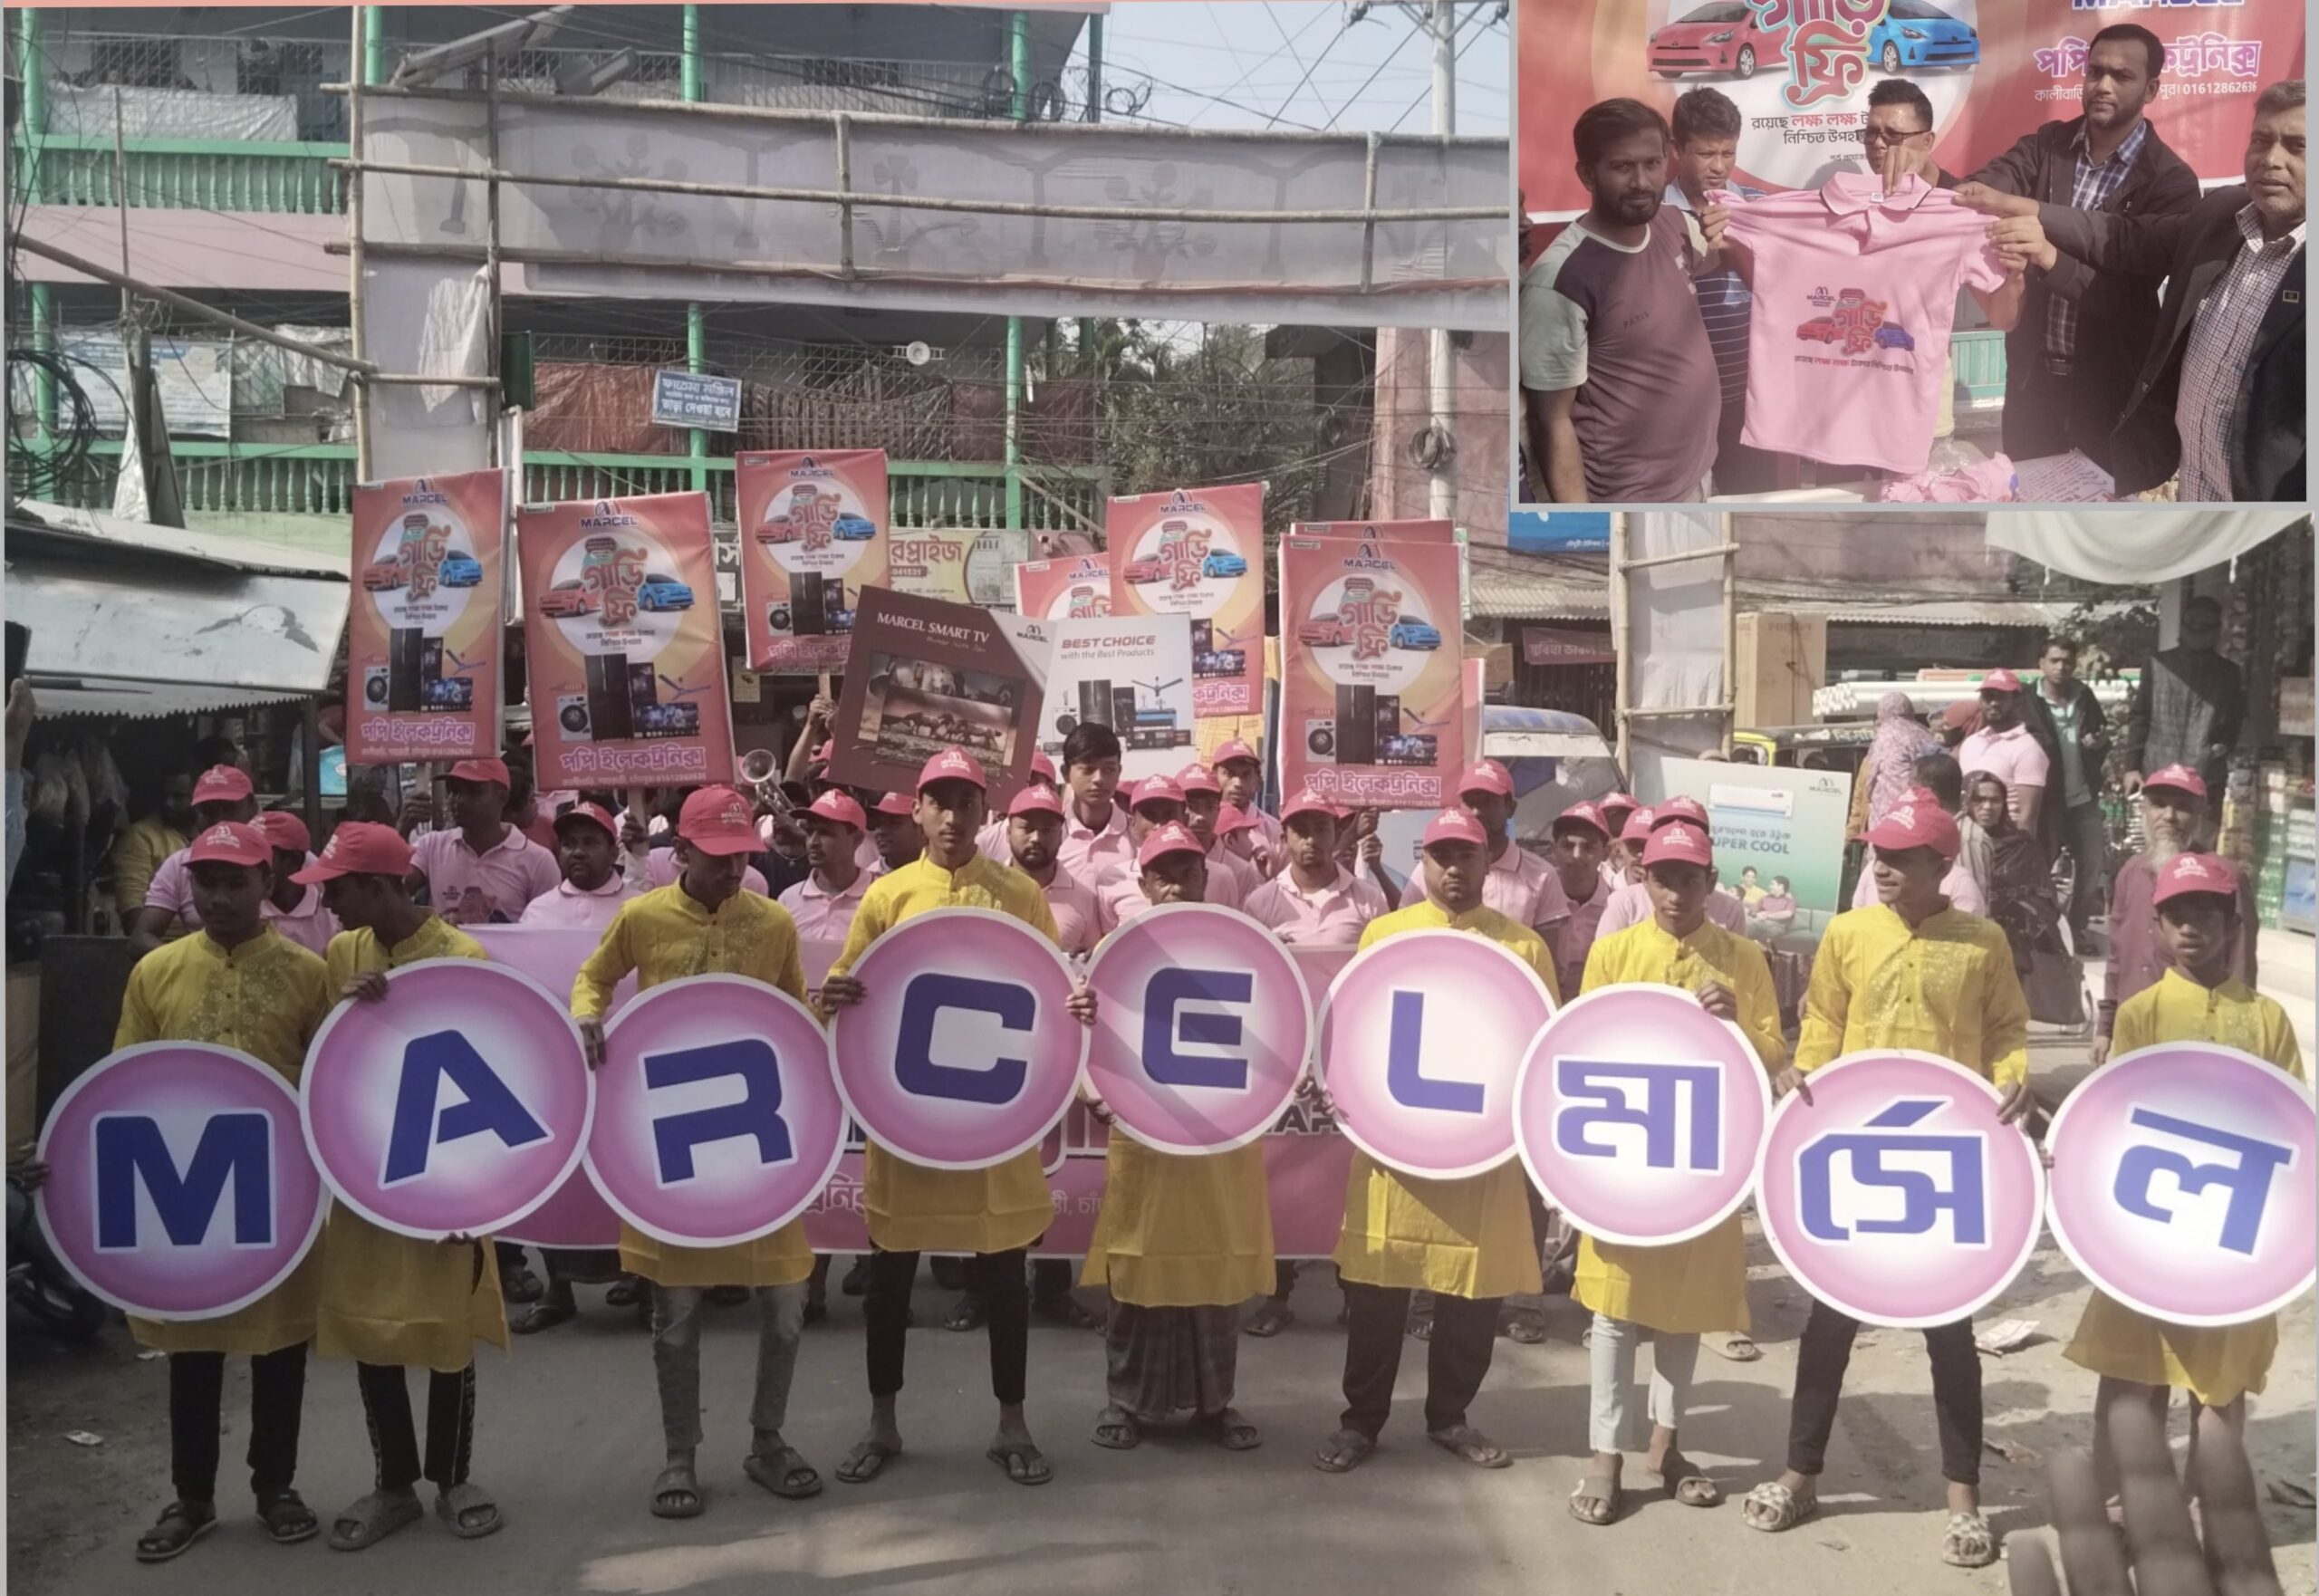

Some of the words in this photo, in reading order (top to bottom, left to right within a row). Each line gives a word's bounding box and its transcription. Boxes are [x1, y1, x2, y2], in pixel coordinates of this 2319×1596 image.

[1785, 19, 1867, 106] ফ্রি
[1791, 115, 1823, 127] লক্ষ
[1826, 113, 1857, 126] লক্ষ
[1784, 130, 1825, 144] নিশ্চিত
[402, 494, 447, 505] MARCEL
[1160, 504, 1207, 514] MARCEL
[581, 516, 638, 528] MARCEL
[890, 533, 963, 563] রপ্রাইজ
[1343, 559, 1397, 570] MARCEL
[877, 612, 926, 632] MARCEL
[928, 621, 970, 640] SMART
[973, 629, 990, 643] TV
[1062, 637, 1099, 649] BEST
[1102, 635, 1156, 648] CHOICE
[1082, 649, 1095, 659] the
[1097, 649, 1116, 659] Best
[1117, 648, 1155, 658] Products
[559, 745, 597, 771] পপি
[1711, 837, 1748, 851] UPER
[1750, 841, 1791, 854] COOL
[894, 972, 1037, 1105] C
[1141, 966, 1254, 1090] E
[1387, 989, 1487, 1114] L
[384, 1028, 549, 1184] A
[643, 1038, 794, 1184] R
[96, 1113, 272, 1248] M
